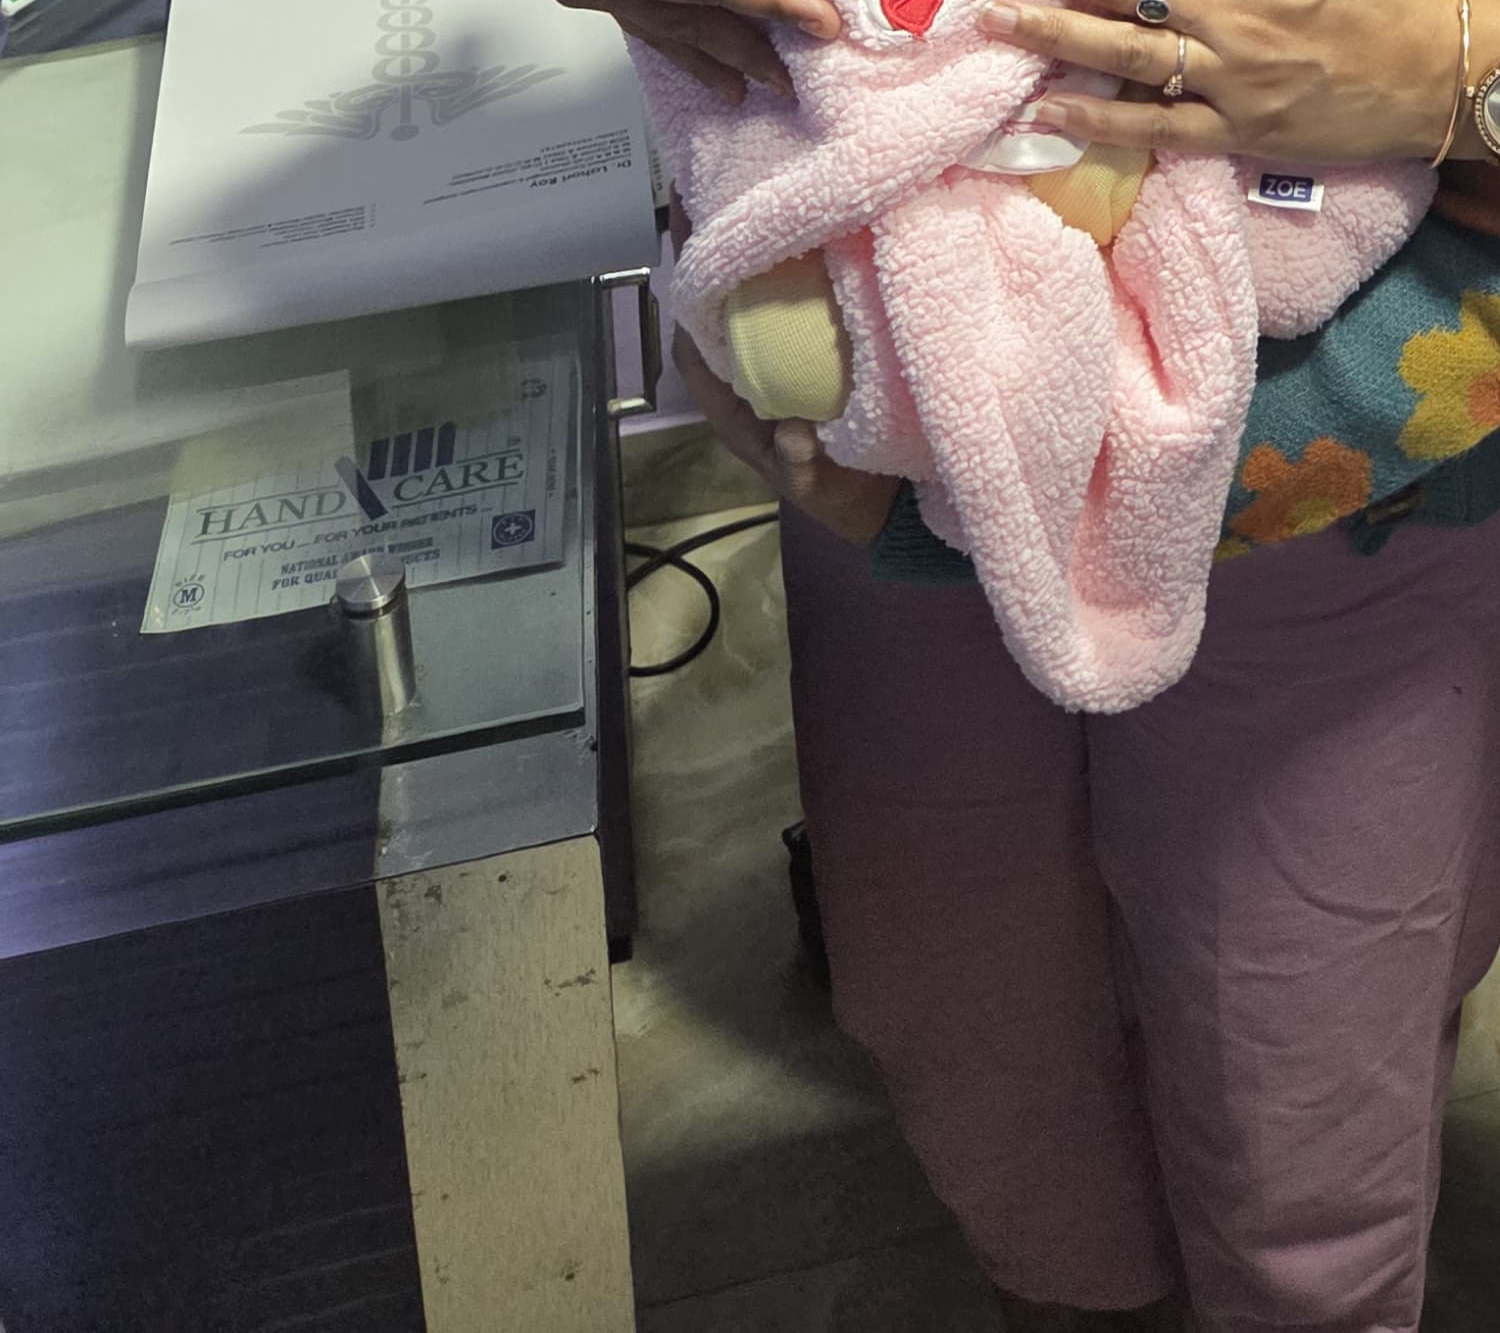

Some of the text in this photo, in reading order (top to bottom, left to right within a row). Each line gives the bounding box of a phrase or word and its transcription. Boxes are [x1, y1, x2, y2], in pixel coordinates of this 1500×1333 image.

[1265, 178, 1308, 199] ZOE
[195, 489, 348, 539] HAND
[393, 452, 525, 502] CARE
[224, 504, 478, 562] FOR YOU FOR YOUR PATIENTS
[280, 555, 339, 576] NATIONAL
[387, 536, 434, 554] WINNER
[181, 587, 197, 604] M
[272, 575, 300, 591] FOR
